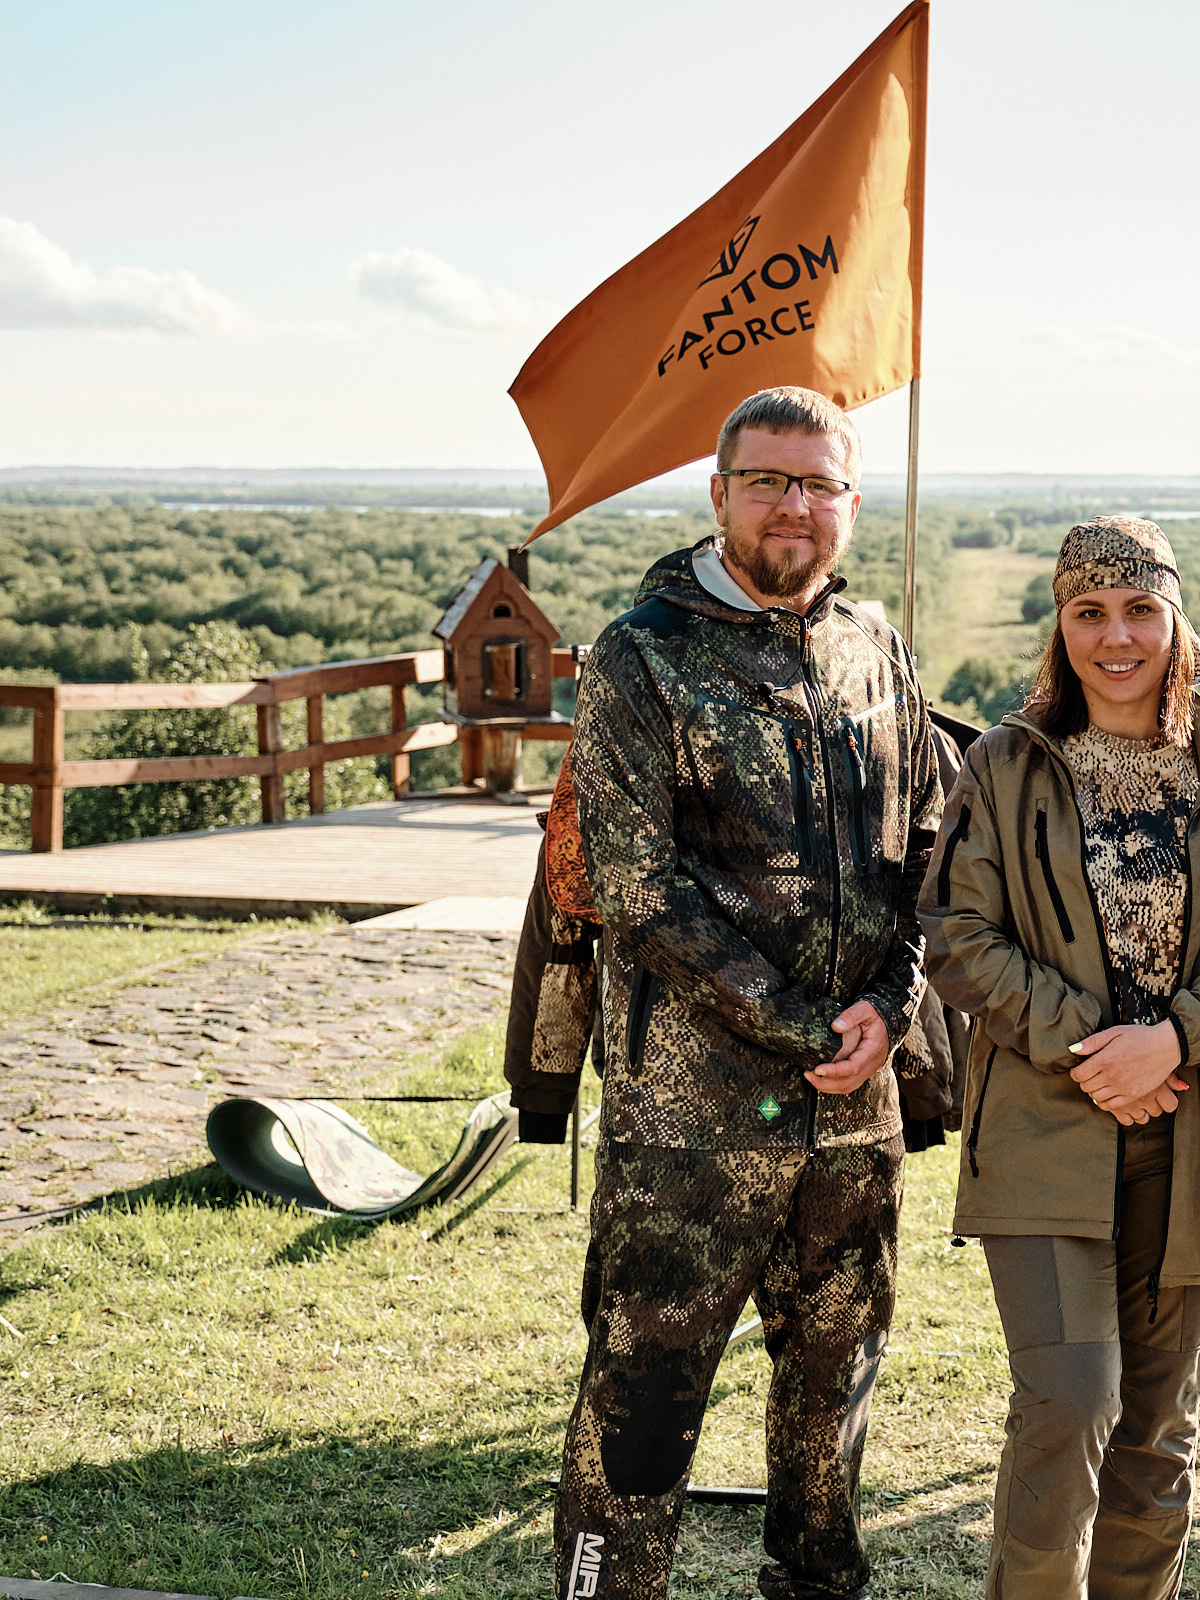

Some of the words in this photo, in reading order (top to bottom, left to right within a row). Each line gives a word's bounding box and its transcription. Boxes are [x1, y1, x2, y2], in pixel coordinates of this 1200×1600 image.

[657, 235, 839, 378] FANTOM
[699, 300, 815, 370] FORCE
[574, 1533, 605, 1600] MIR
